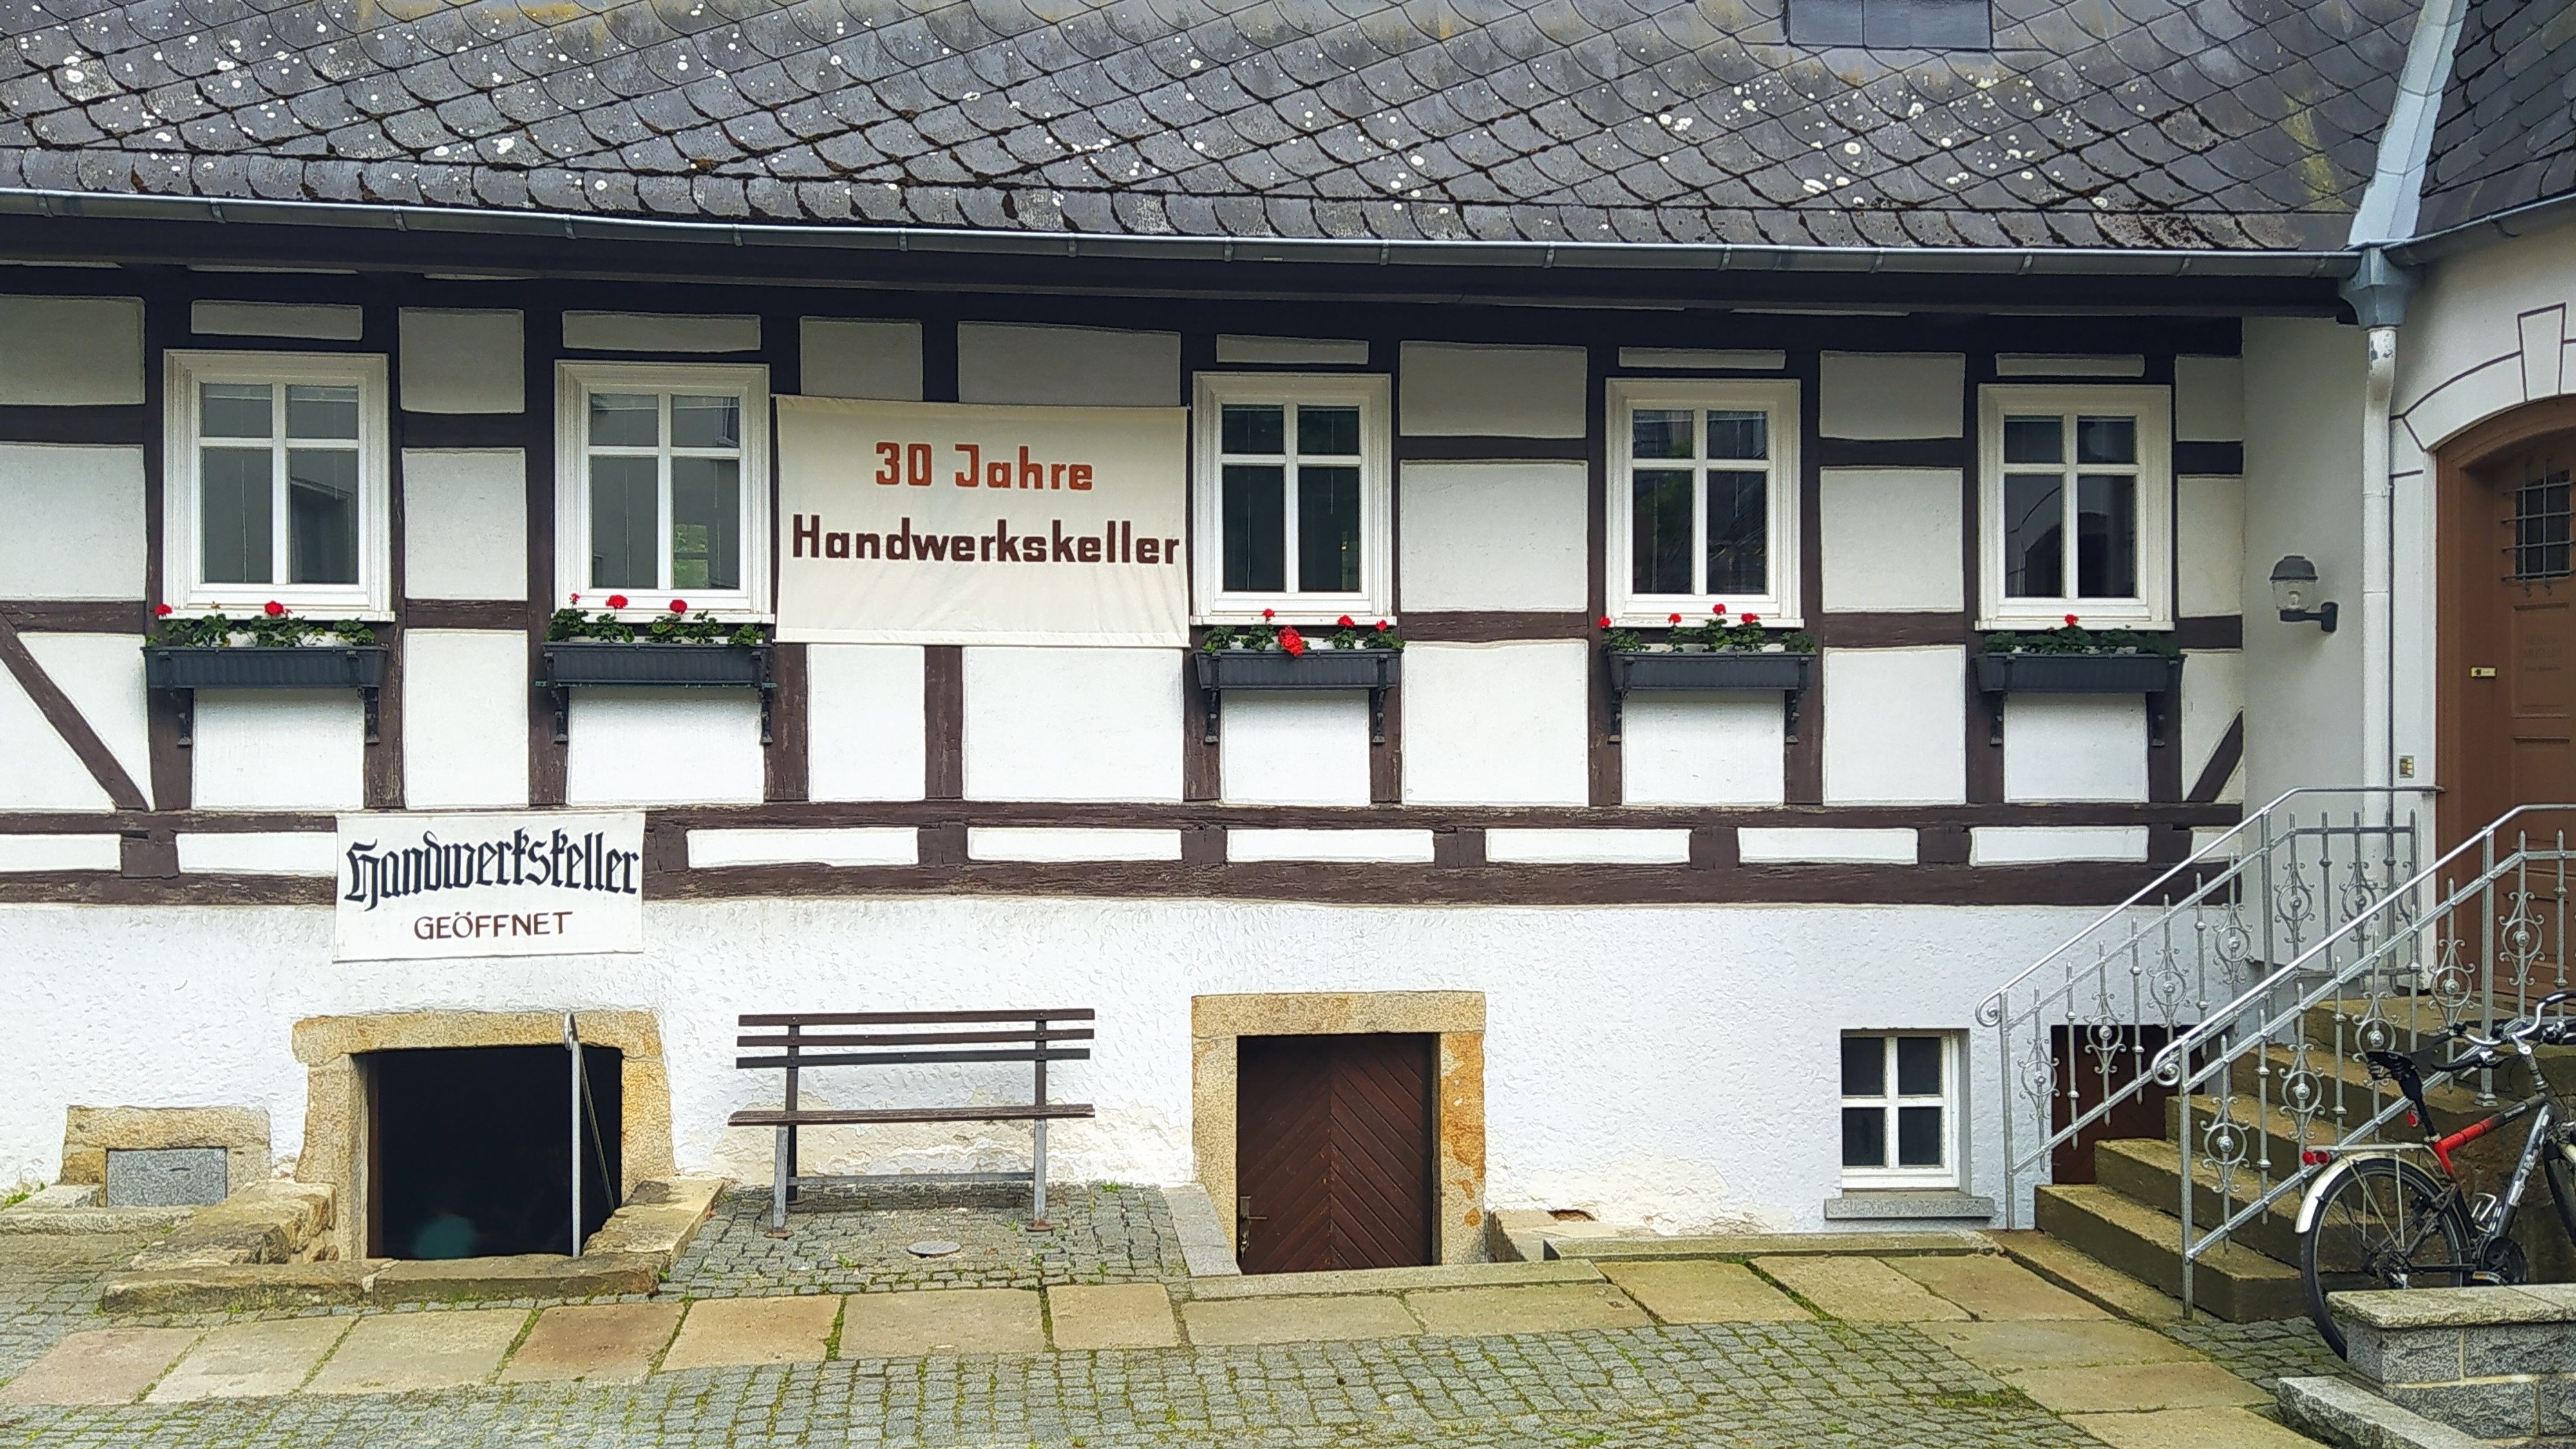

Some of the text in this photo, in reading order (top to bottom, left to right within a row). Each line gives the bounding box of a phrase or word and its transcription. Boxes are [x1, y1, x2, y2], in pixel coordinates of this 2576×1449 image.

[875, 441, 1094, 491] 30 Jahre
[792, 513, 1180, 564] Handwerkskeller
[343, 827, 640, 912] Handwerkskeller
[413, 911, 574, 940] GEÖFFNET
